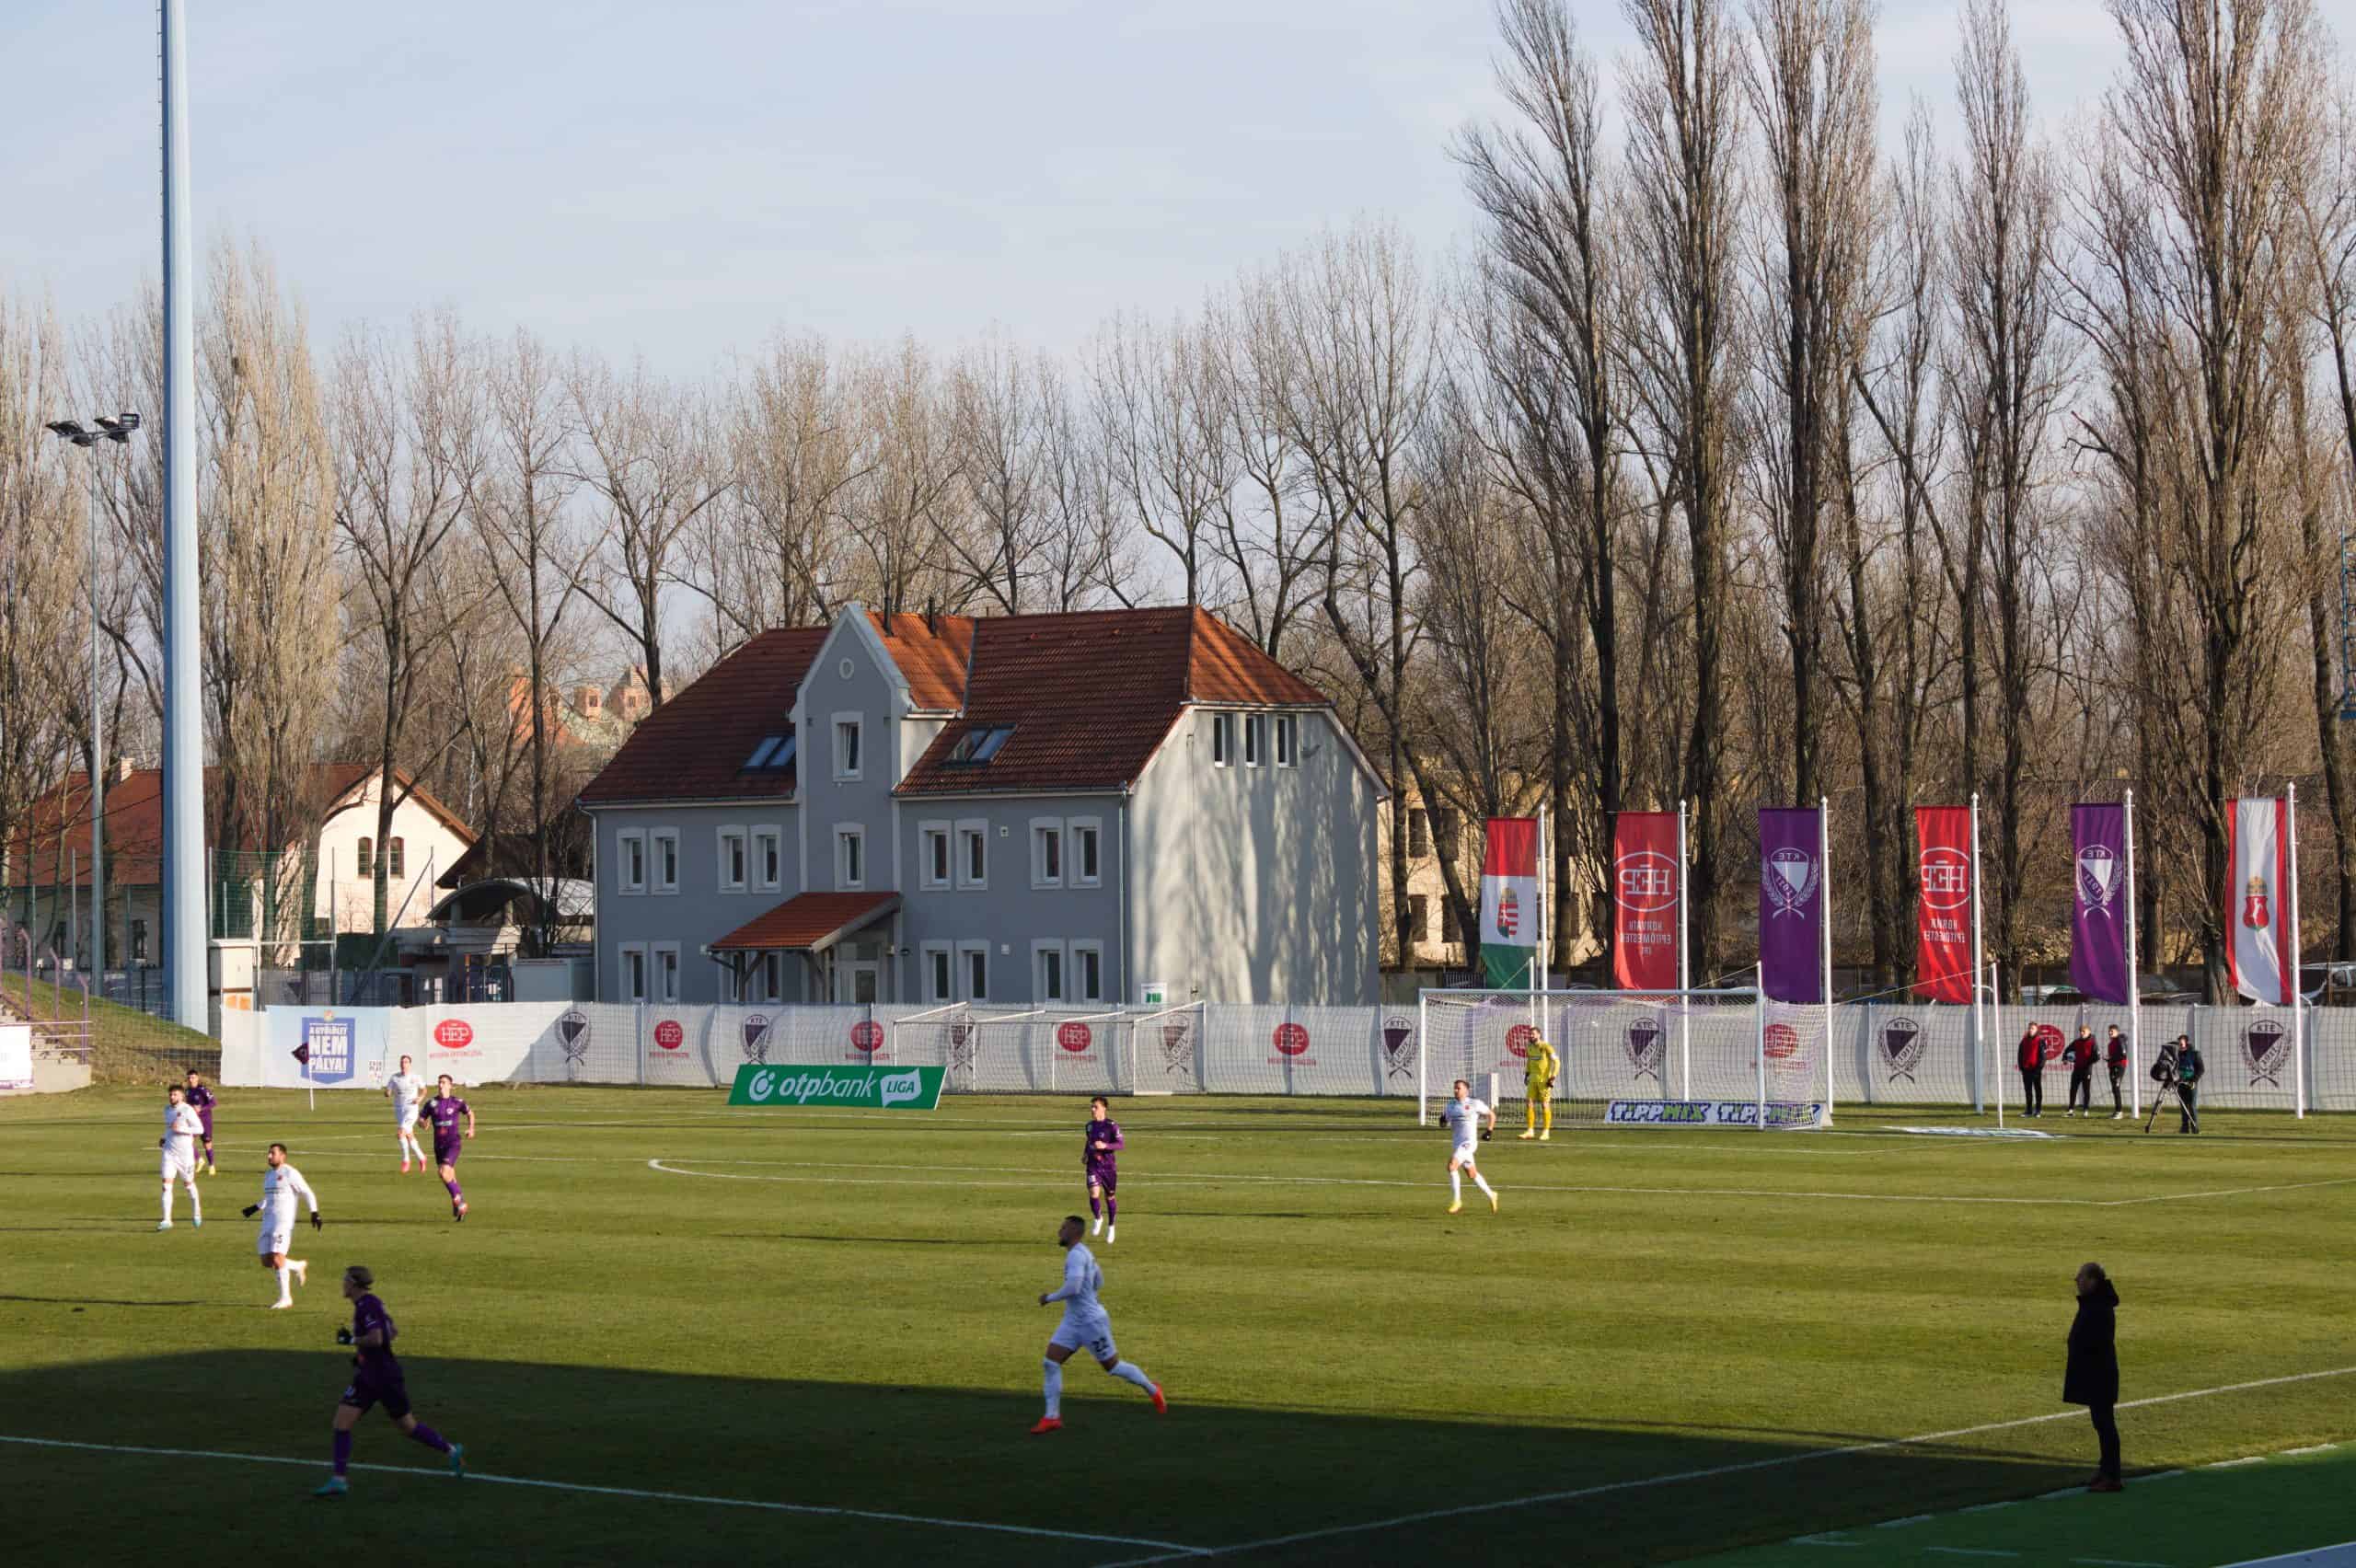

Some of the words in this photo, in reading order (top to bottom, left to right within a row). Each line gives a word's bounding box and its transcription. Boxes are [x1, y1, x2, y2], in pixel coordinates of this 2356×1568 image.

[1893, 1021, 1913, 1031] KTE
[309, 1035, 348, 1055] NEM
[780, 1070, 877, 1103] otpbank
[886, 1080, 915, 1093] LIGA
